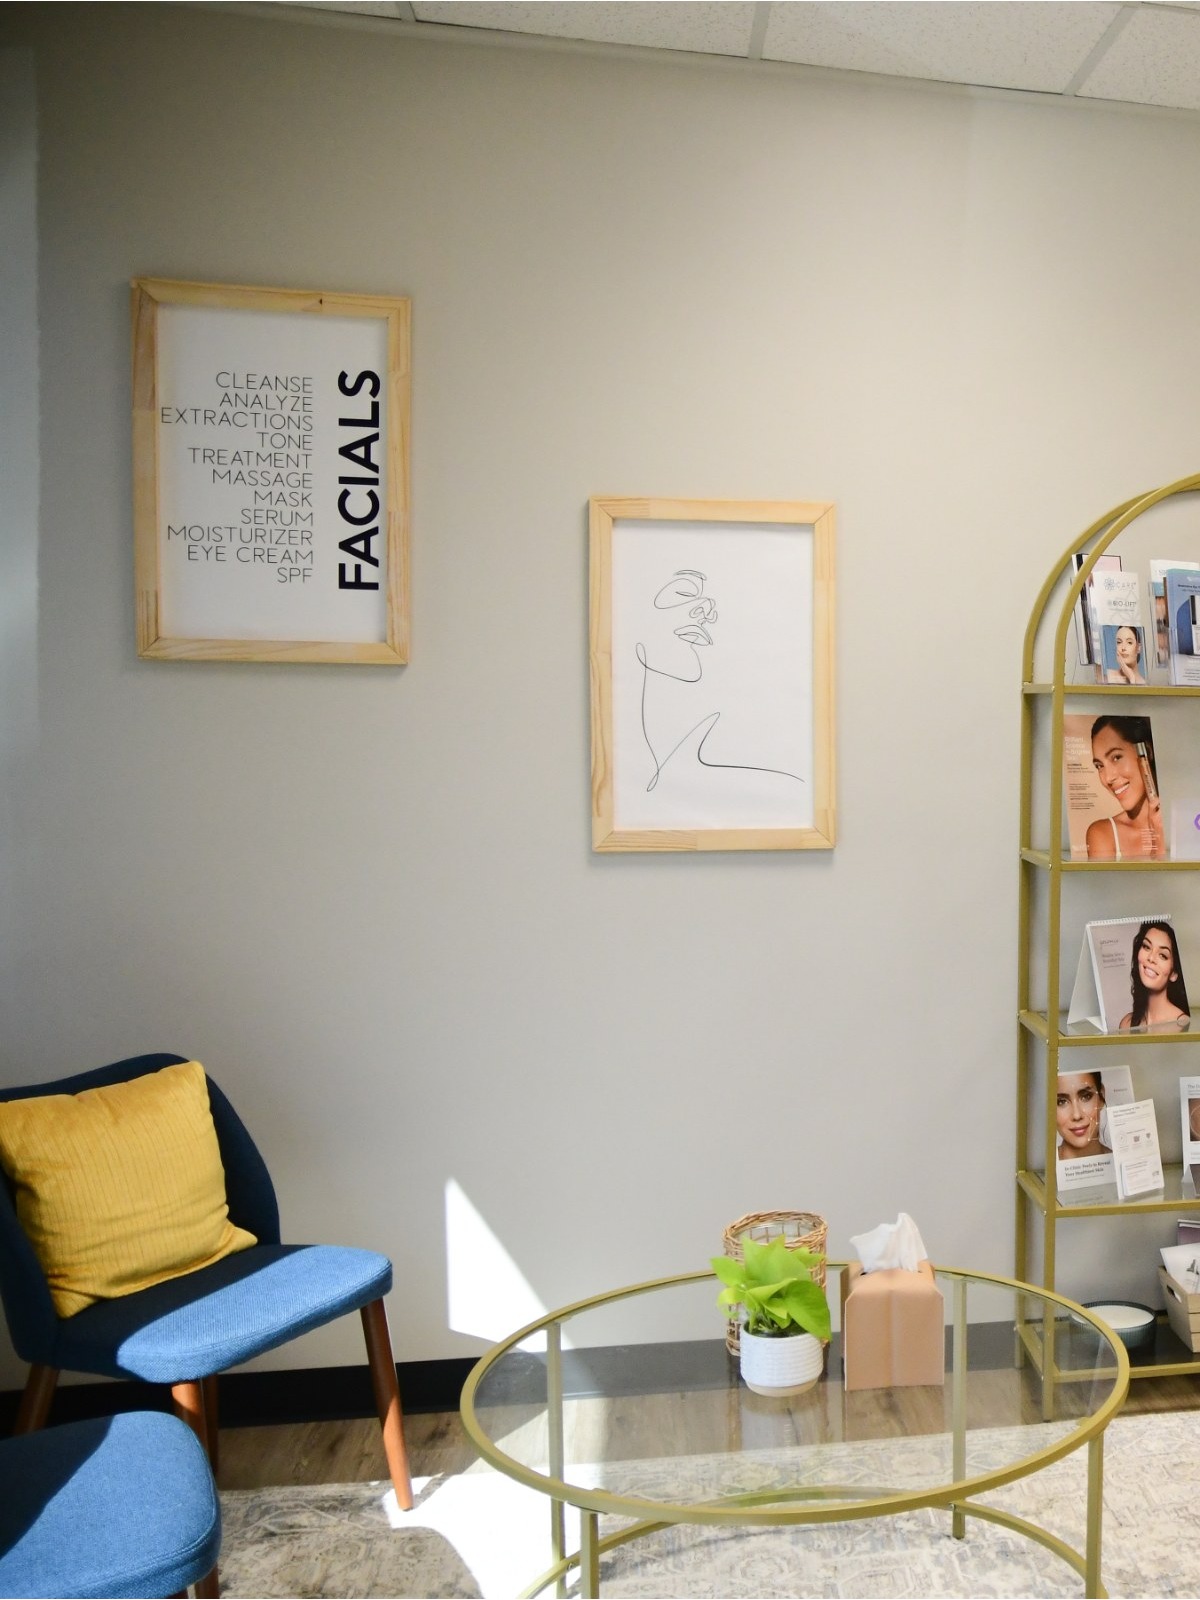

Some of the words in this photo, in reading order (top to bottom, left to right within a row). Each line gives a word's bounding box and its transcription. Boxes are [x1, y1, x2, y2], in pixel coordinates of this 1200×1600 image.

[216, 371, 313, 393] CLEANSE
[219, 392, 313, 412] ANALYZE
[161, 407, 313, 432] EXTRACTIONS
[256, 432, 313, 450] TONE
[187, 447, 313, 469] TREATMENT
[212, 468, 313, 488] MASSAGE
[338, 370, 381, 591] FACIALS
[254, 490, 313, 507] MASK
[241, 508, 313, 527] SERUM
[168, 525, 313, 545] MOISTURIZER
[188, 544, 227, 561] EYE
[236, 546, 313, 564] CREAM
[277, 567, 313, 583] SPF
